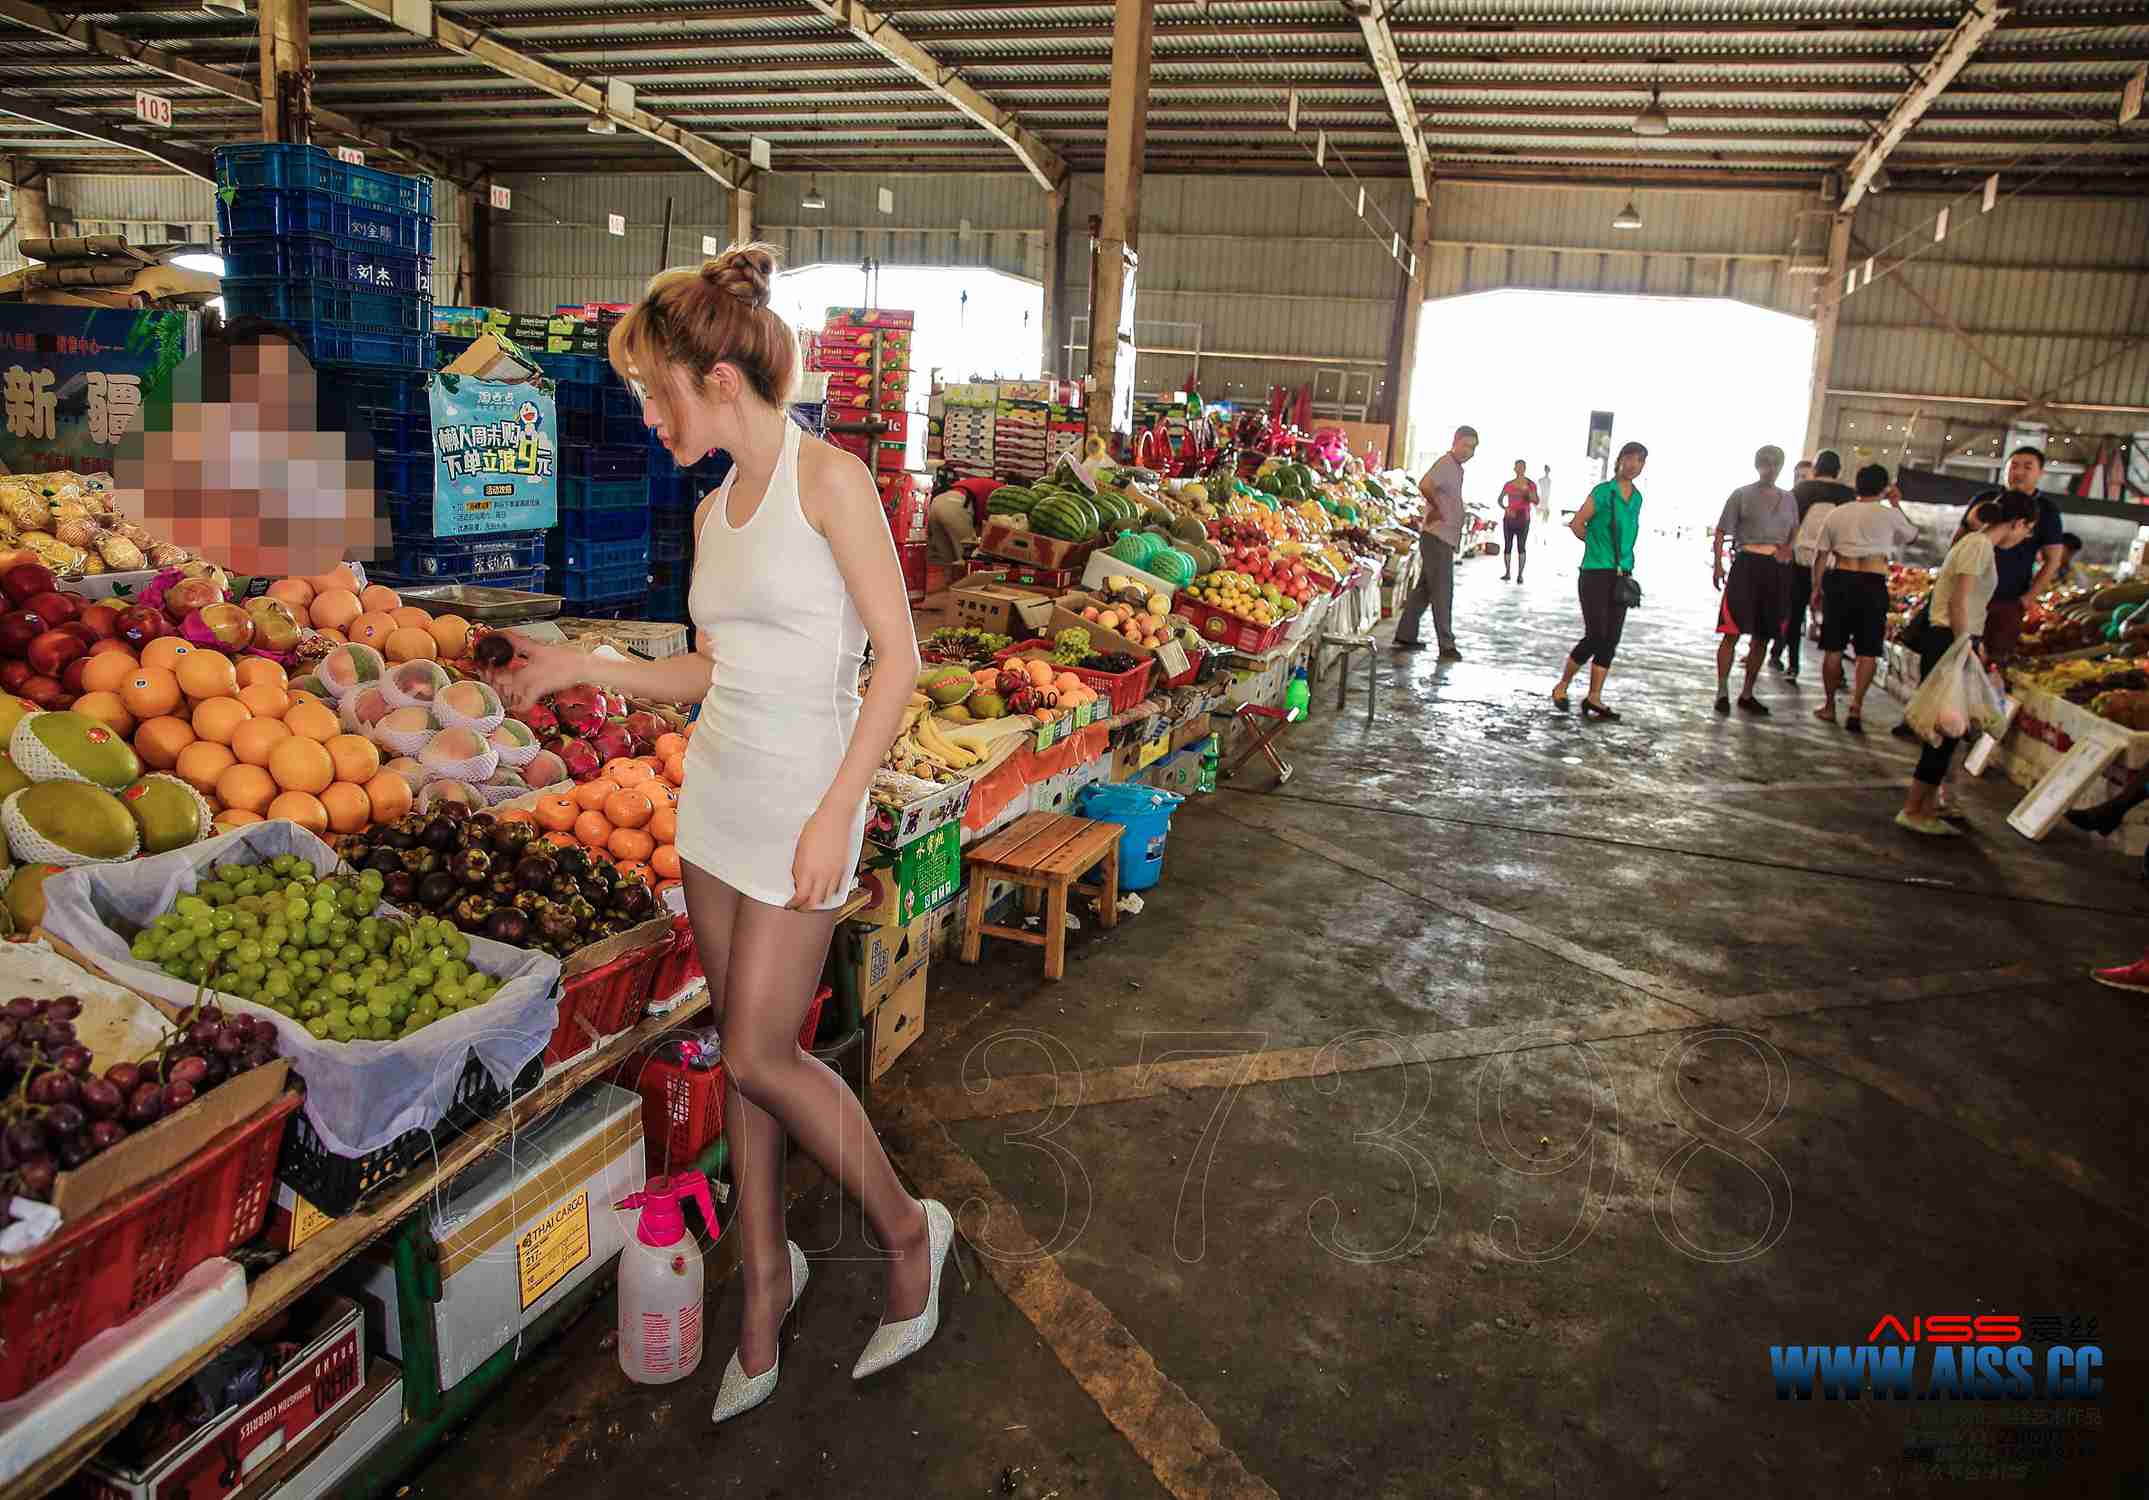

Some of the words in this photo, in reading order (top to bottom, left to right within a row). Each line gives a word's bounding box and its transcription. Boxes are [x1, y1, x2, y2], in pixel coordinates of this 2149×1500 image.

[140, 96, 170, 123] 103
[3, 364, 142, 445] 新疆
[533, 1216, 555, 1238] THAI
[555, 1194, 585, 1223] CARGO
[239, 1405, 277, 1441] CHERRIES
